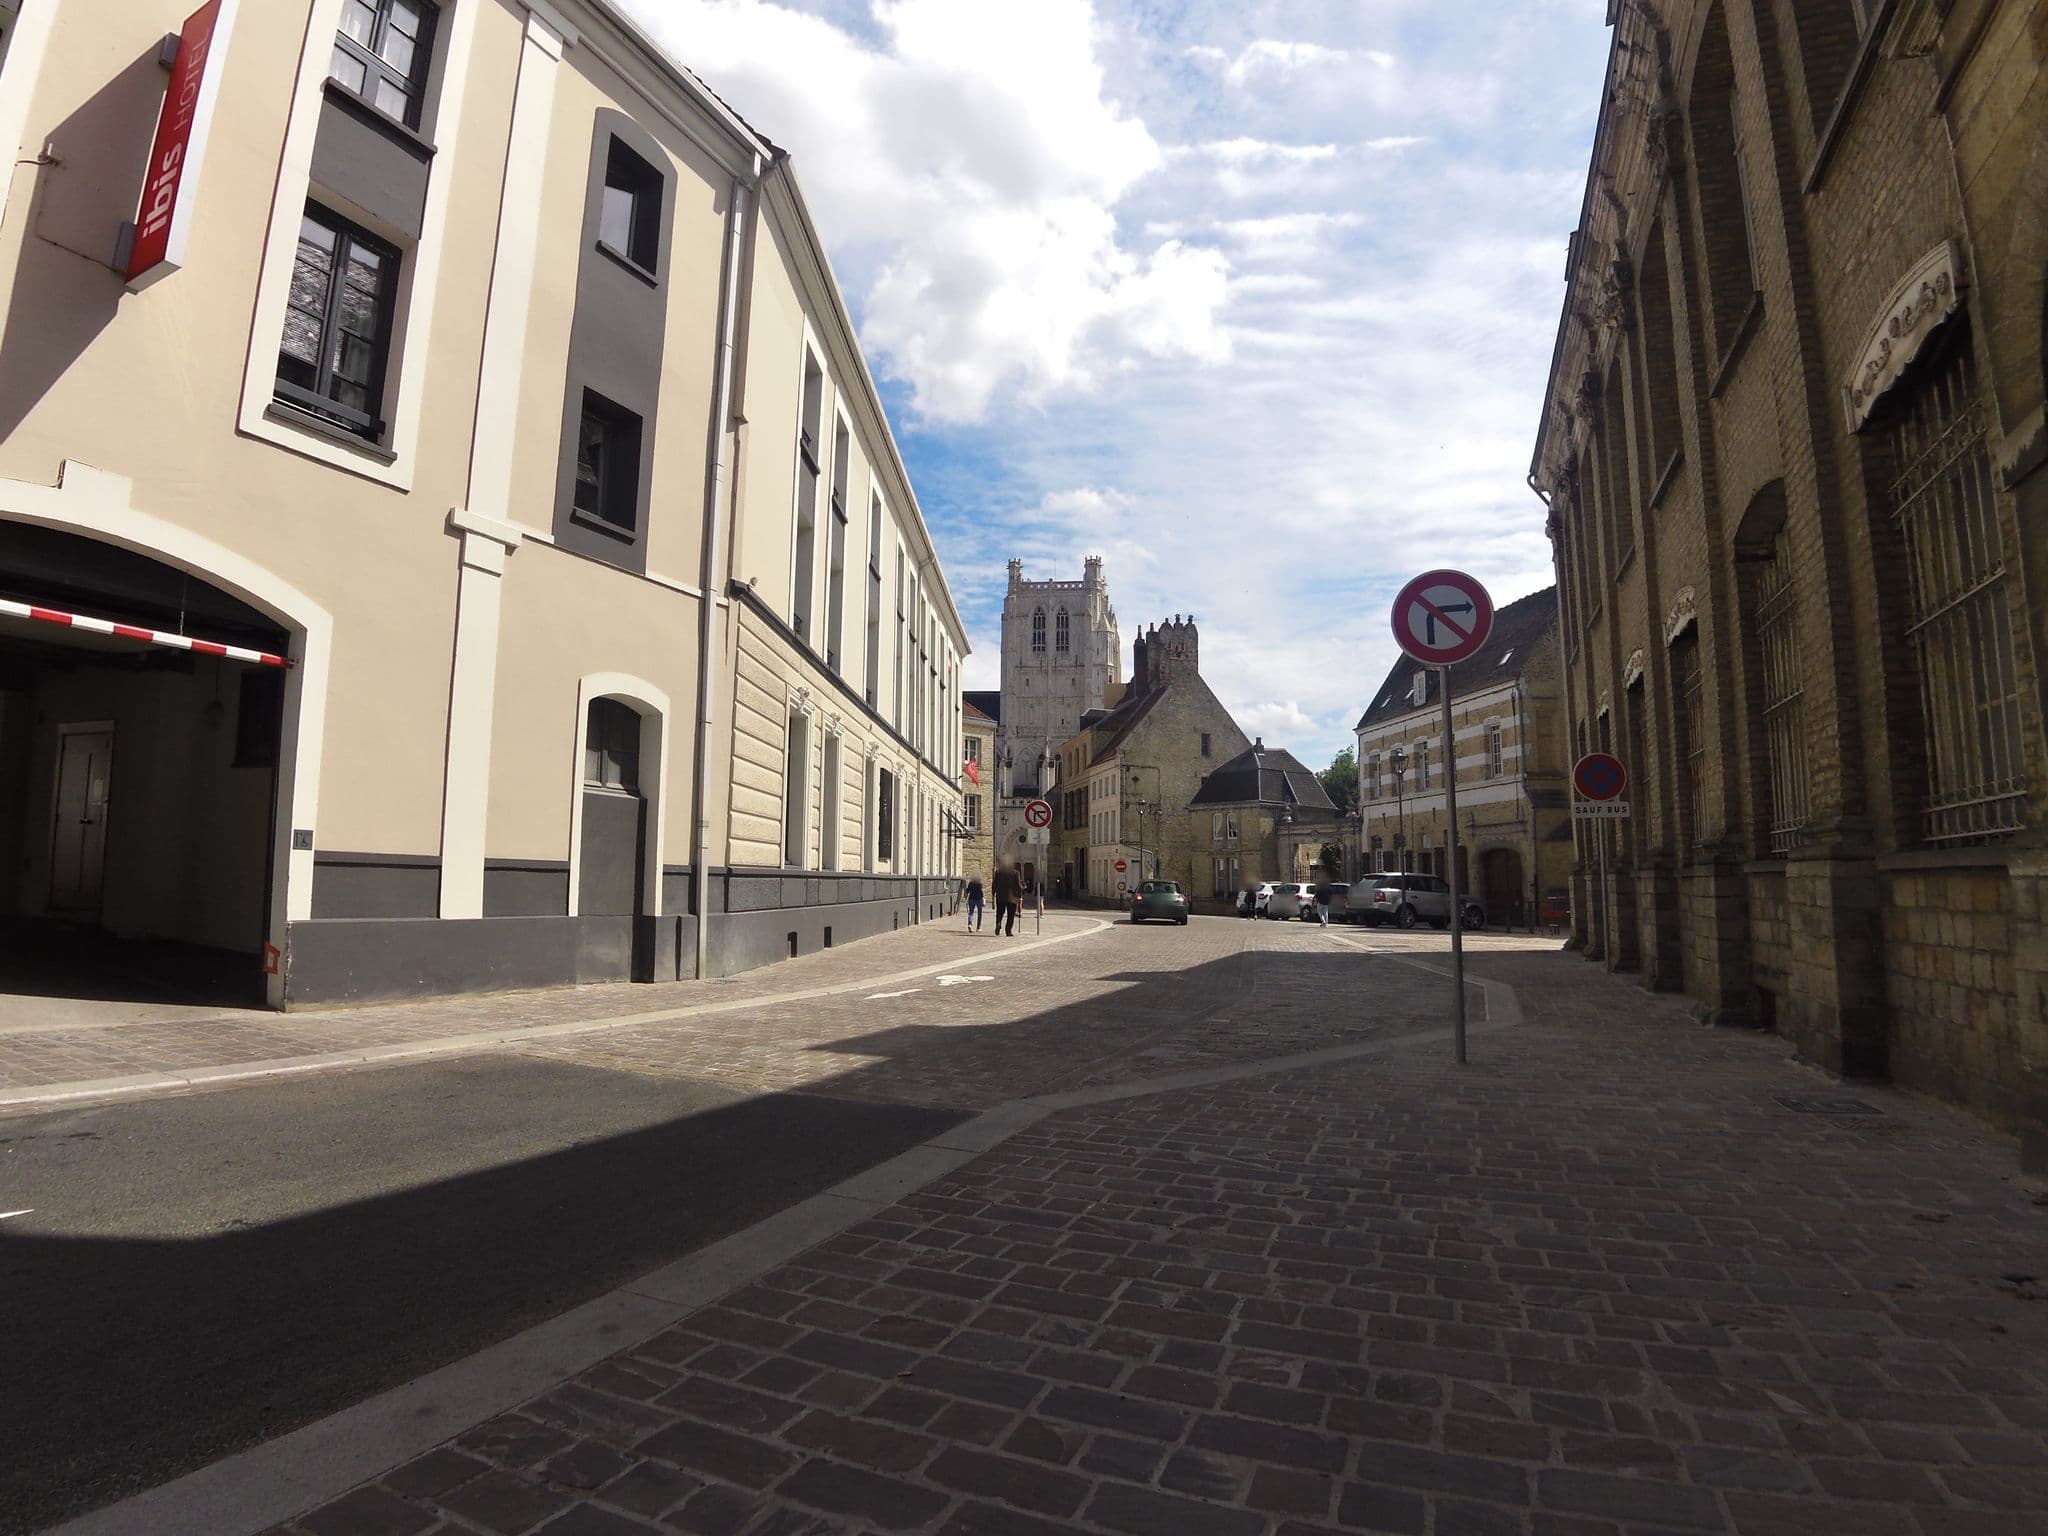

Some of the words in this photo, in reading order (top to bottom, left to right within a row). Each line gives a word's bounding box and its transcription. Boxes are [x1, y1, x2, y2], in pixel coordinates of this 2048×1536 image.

[143, 142, 182, 238] ibis
[174, 28, 210, 131] HOTEL
[1575, 806, 1602, 814] SAUF
[1607, 805, 1628, 813] BUS
